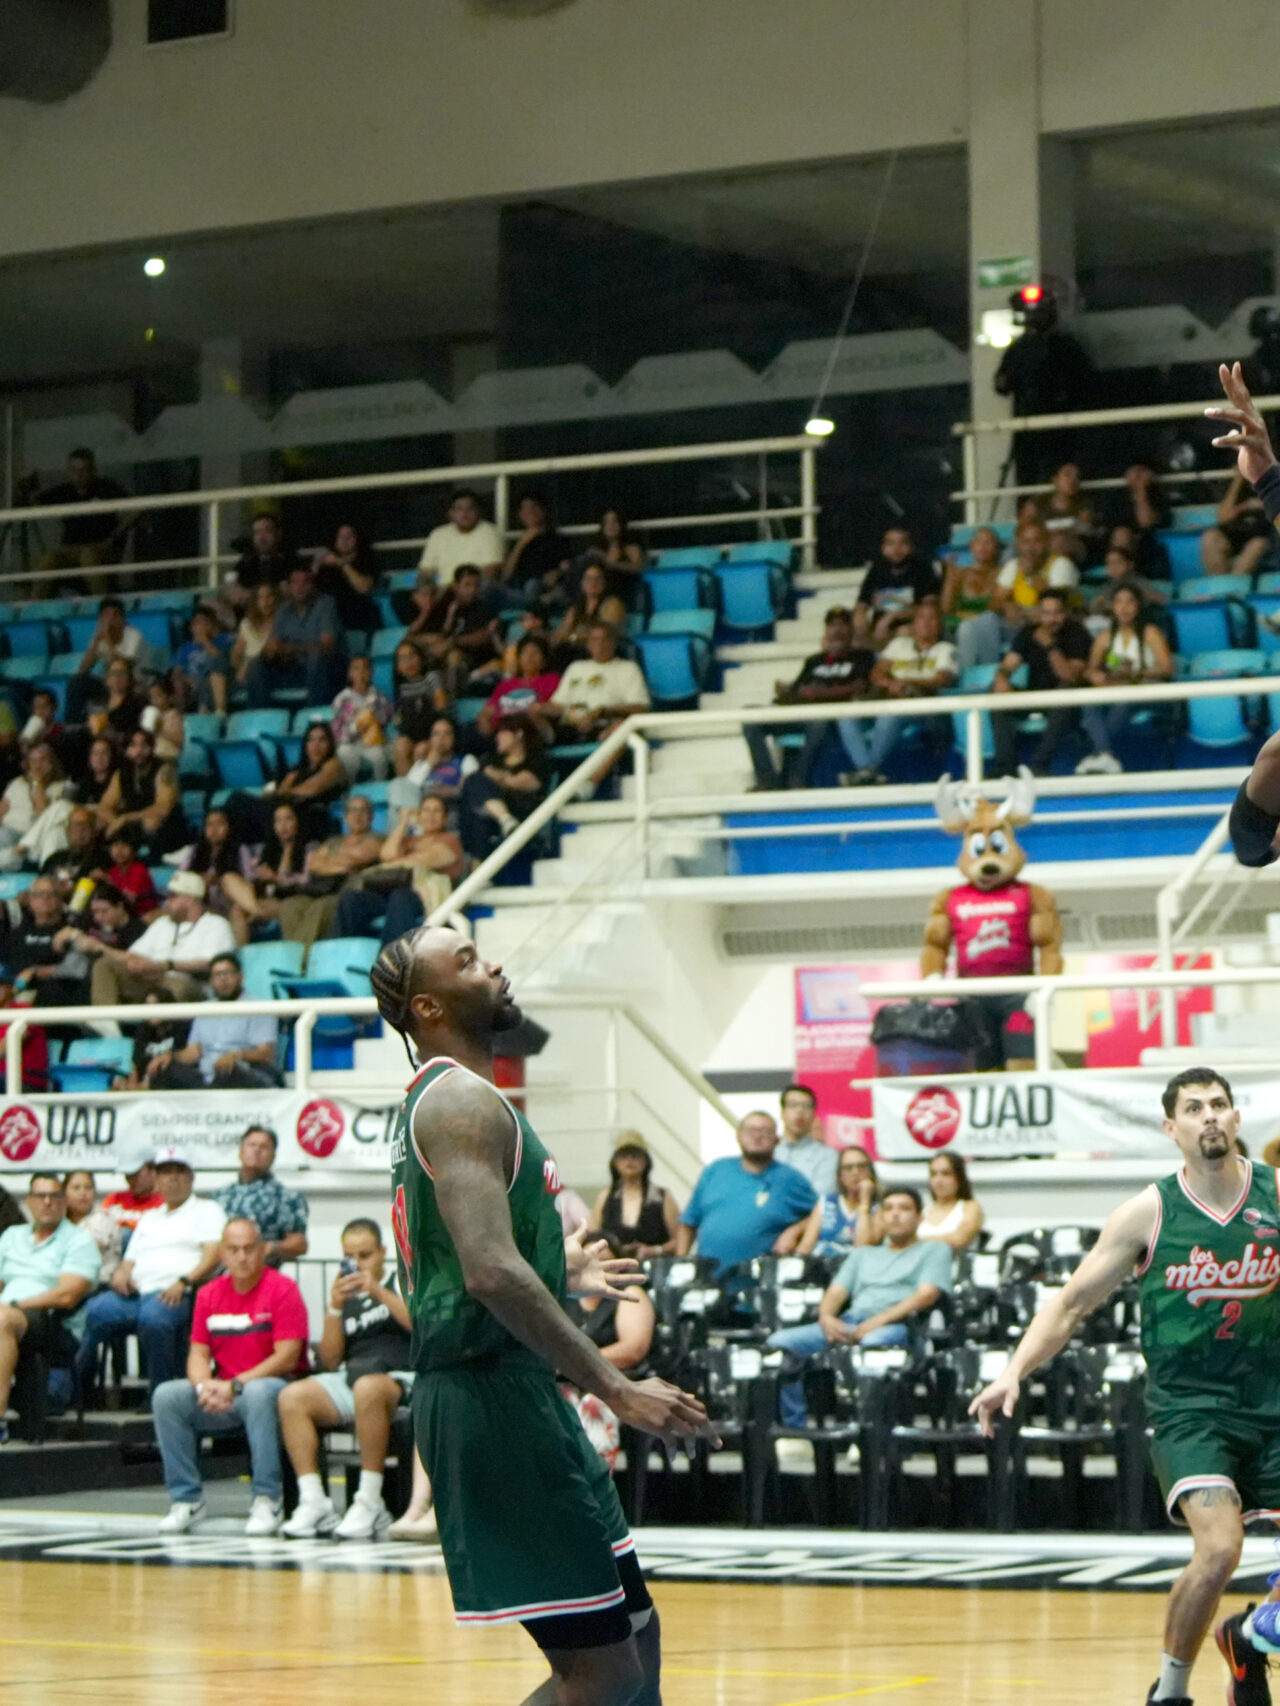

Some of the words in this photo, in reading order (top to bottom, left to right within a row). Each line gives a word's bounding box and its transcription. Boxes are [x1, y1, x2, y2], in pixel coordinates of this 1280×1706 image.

[141, 1113, 201, 1127] SIEMPRE
[205, 1110, 273, 1127] GRANDES
[968, 1083, 1055, 1129] UAD
[46, 1104, 117, 1146] UAD
[151, 1132, 210, 1146] SIEMPRE
[215, 1131, 244, 1146] LOB
[352, 1108, 397, 1144] CI
[1189, 1245, 1215, 1265] los
[1215, 1301, 1243, 1340] 2
